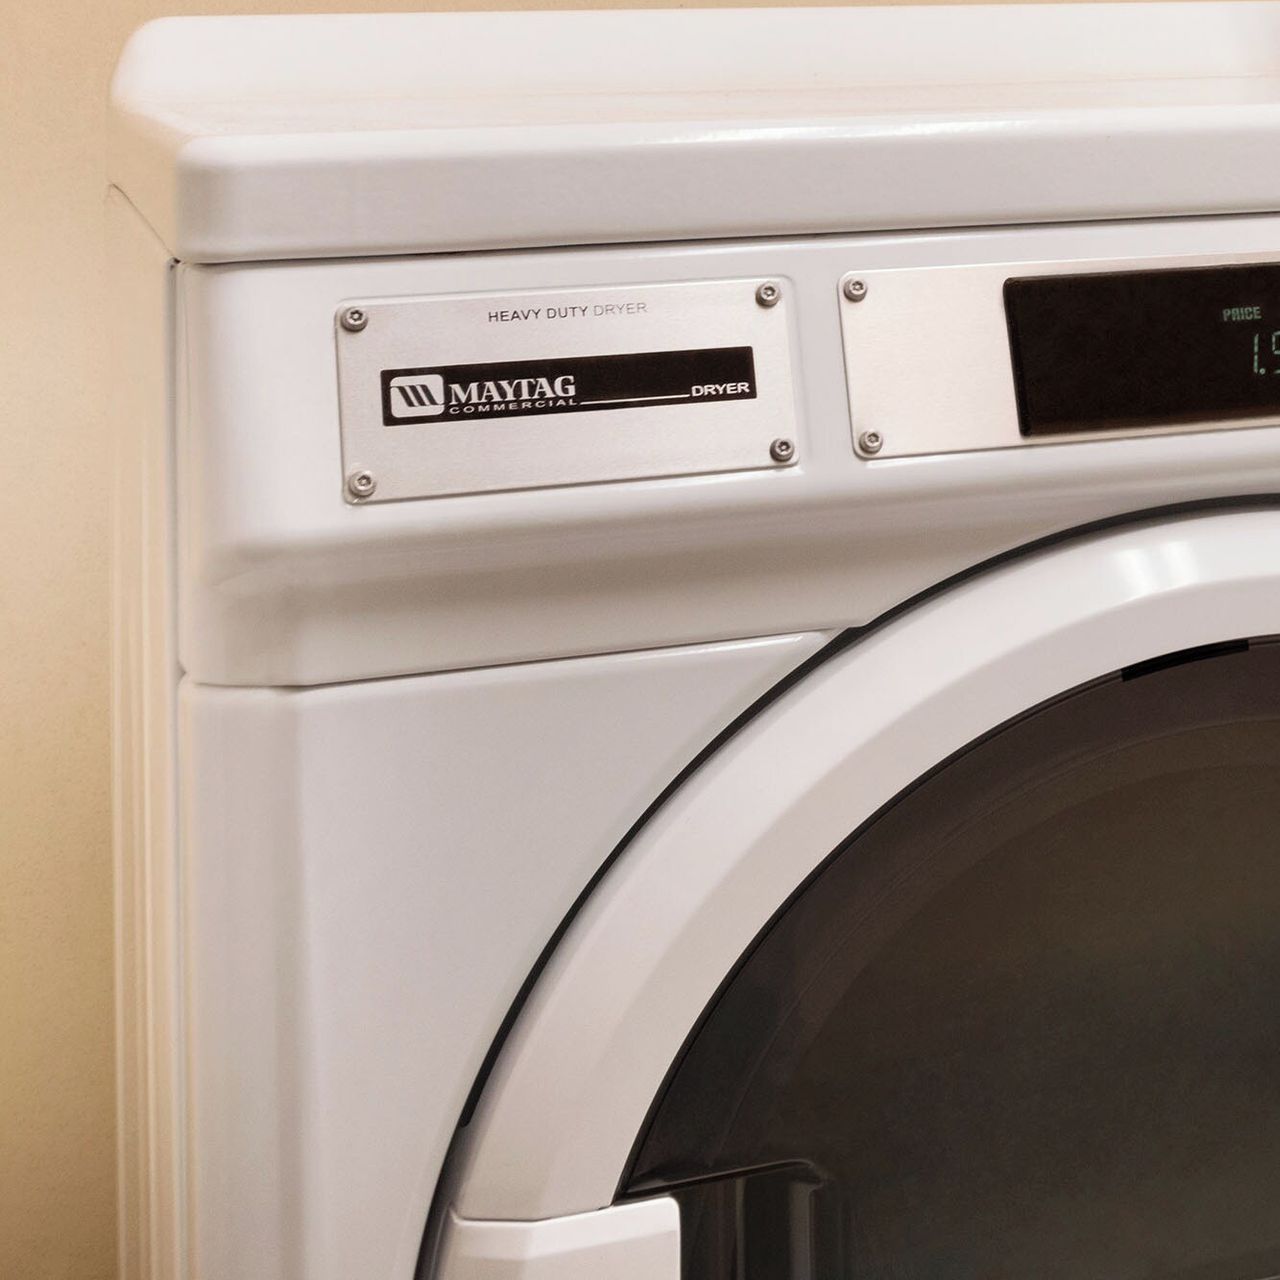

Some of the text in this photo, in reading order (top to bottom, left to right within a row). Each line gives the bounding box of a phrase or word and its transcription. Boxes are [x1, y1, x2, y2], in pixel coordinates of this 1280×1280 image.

[488, 302, 648, 323] HEAVY DUTY DRYER
[1222, 306, 1262, 321] PRICE
[449, 375, 576, 404] MAYTAG
[691, 382, 750, 398] DRYER
[450, 399, 580, 414] COMMERCIAL
